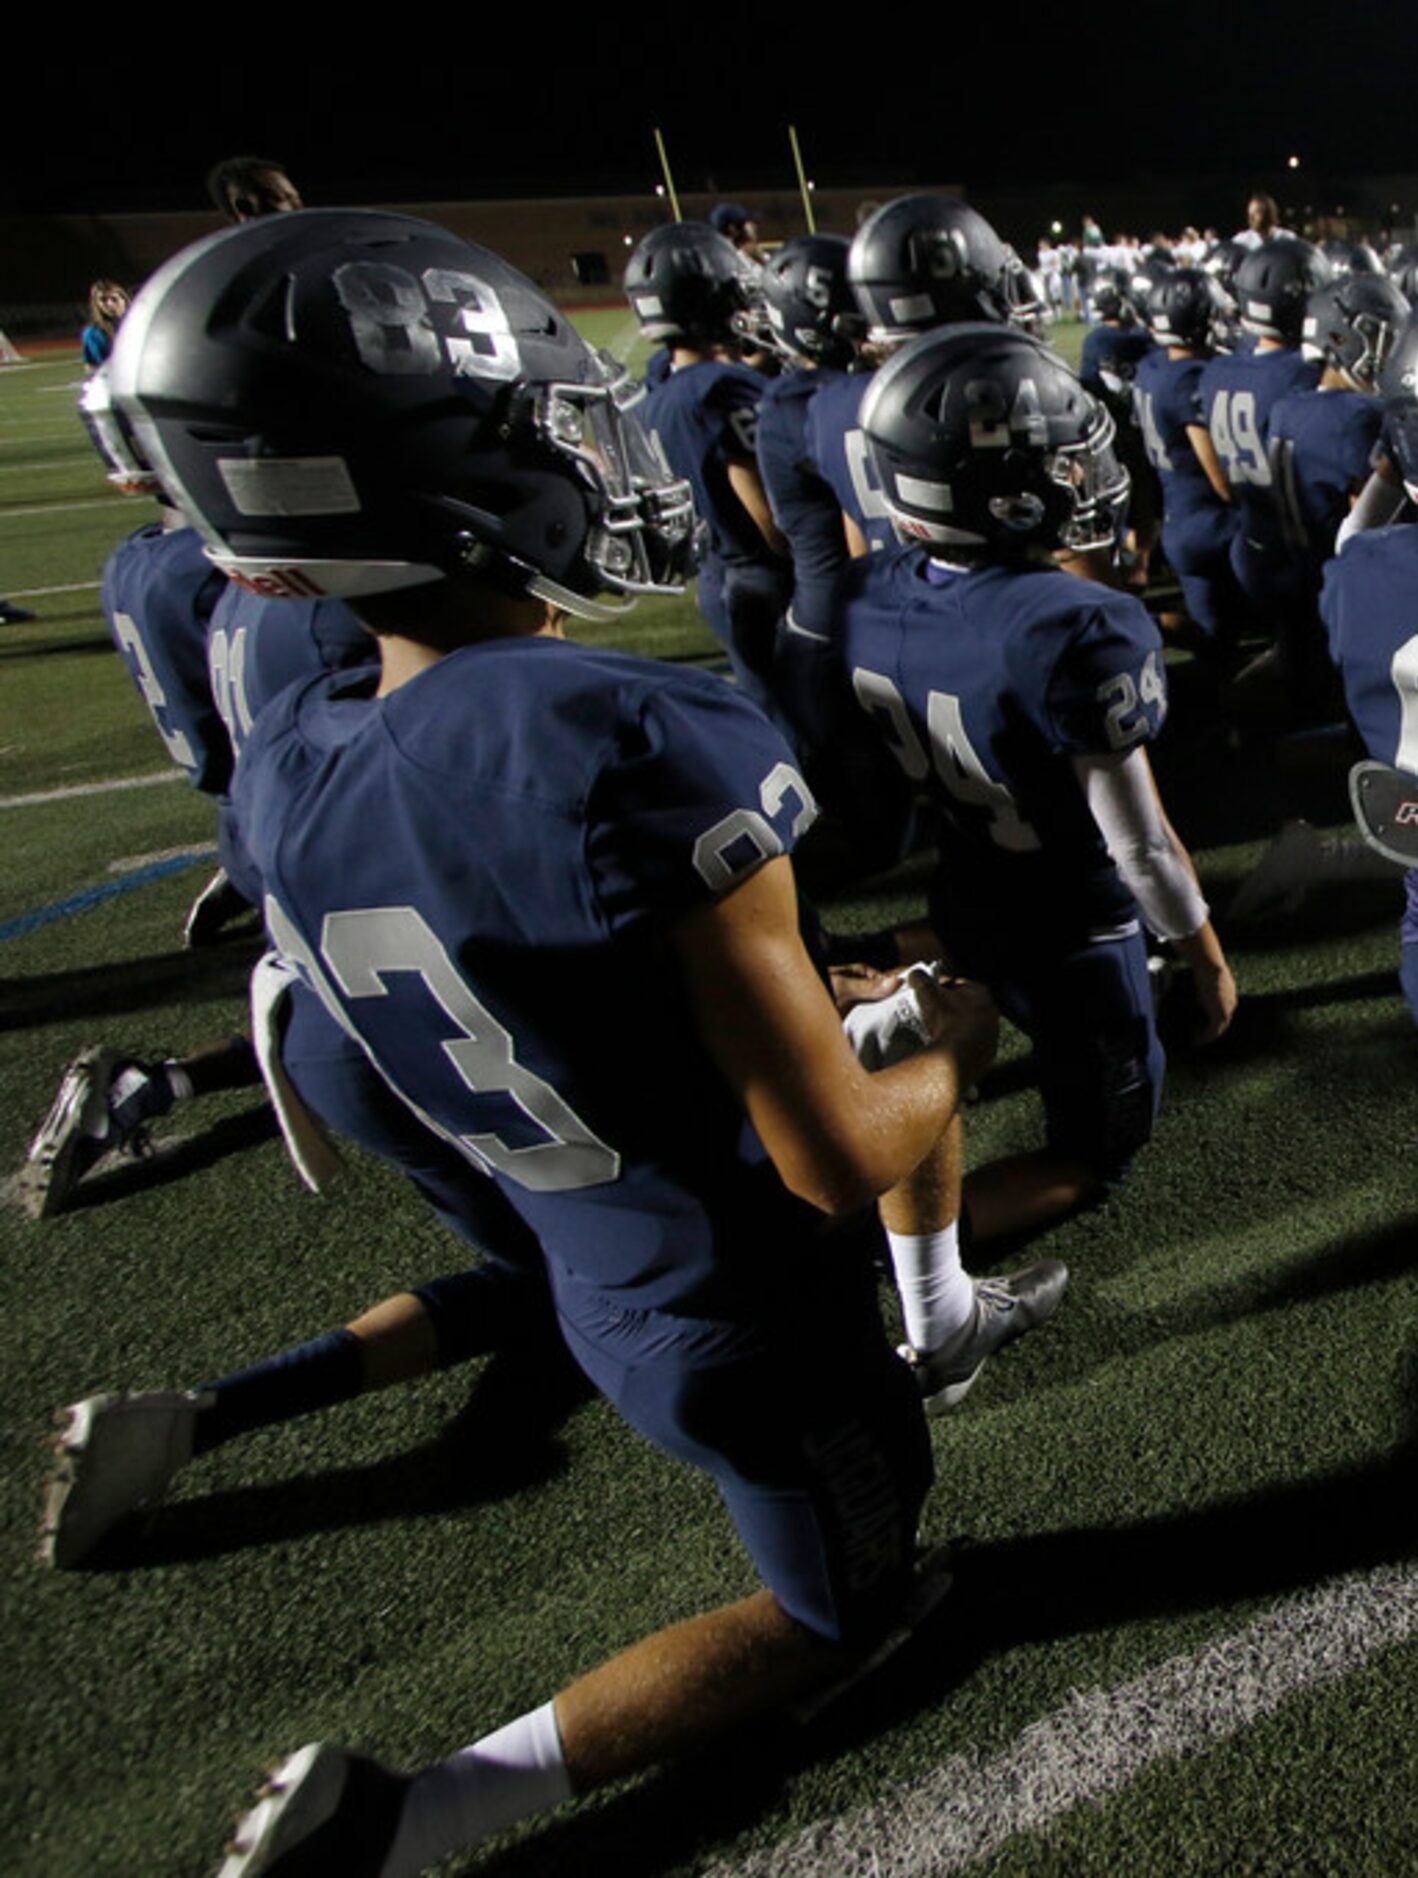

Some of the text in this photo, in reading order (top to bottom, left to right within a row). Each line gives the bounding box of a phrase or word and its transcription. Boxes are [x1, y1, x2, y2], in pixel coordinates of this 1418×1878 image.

[331, 261, 523, 382] 83
[1210, 389, 1272, 487] 49
[1098, 650, 1168, 750] 24
